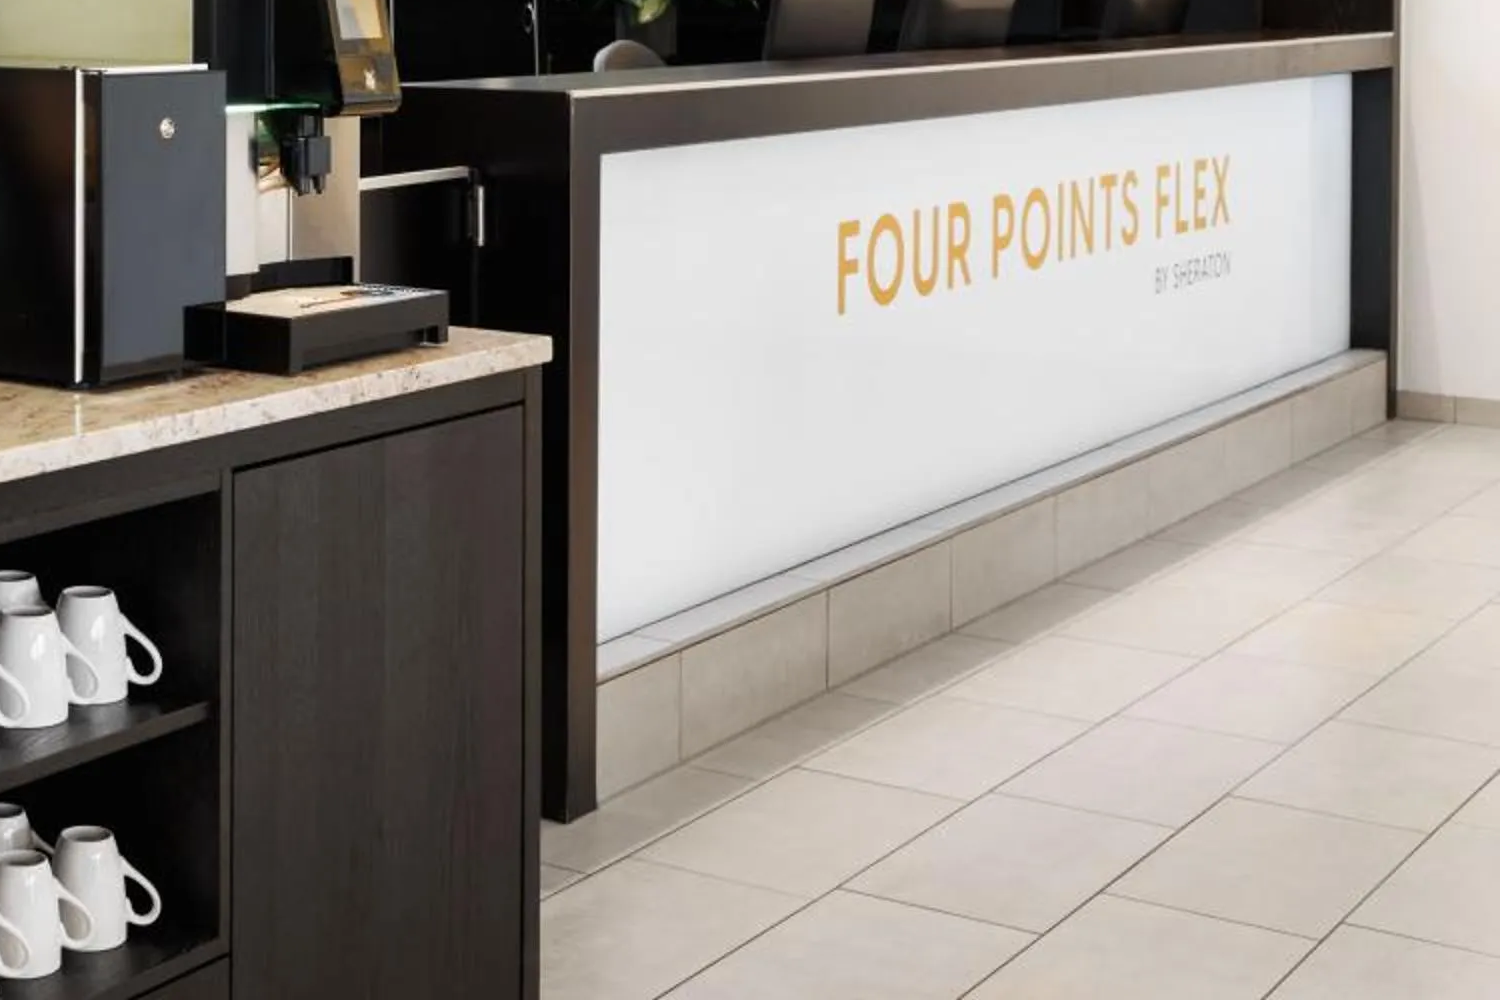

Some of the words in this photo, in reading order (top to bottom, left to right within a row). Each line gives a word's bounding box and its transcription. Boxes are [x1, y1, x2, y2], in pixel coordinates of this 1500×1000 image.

[837, 200, 971, 315] FOUR
[991, 170, 1139, 279] POINTS
[1154, 154, 1231, 239] FLEX
[1155, 265, 1170, 294] BY
[1171, 251, 1231, 290] SHERATON
